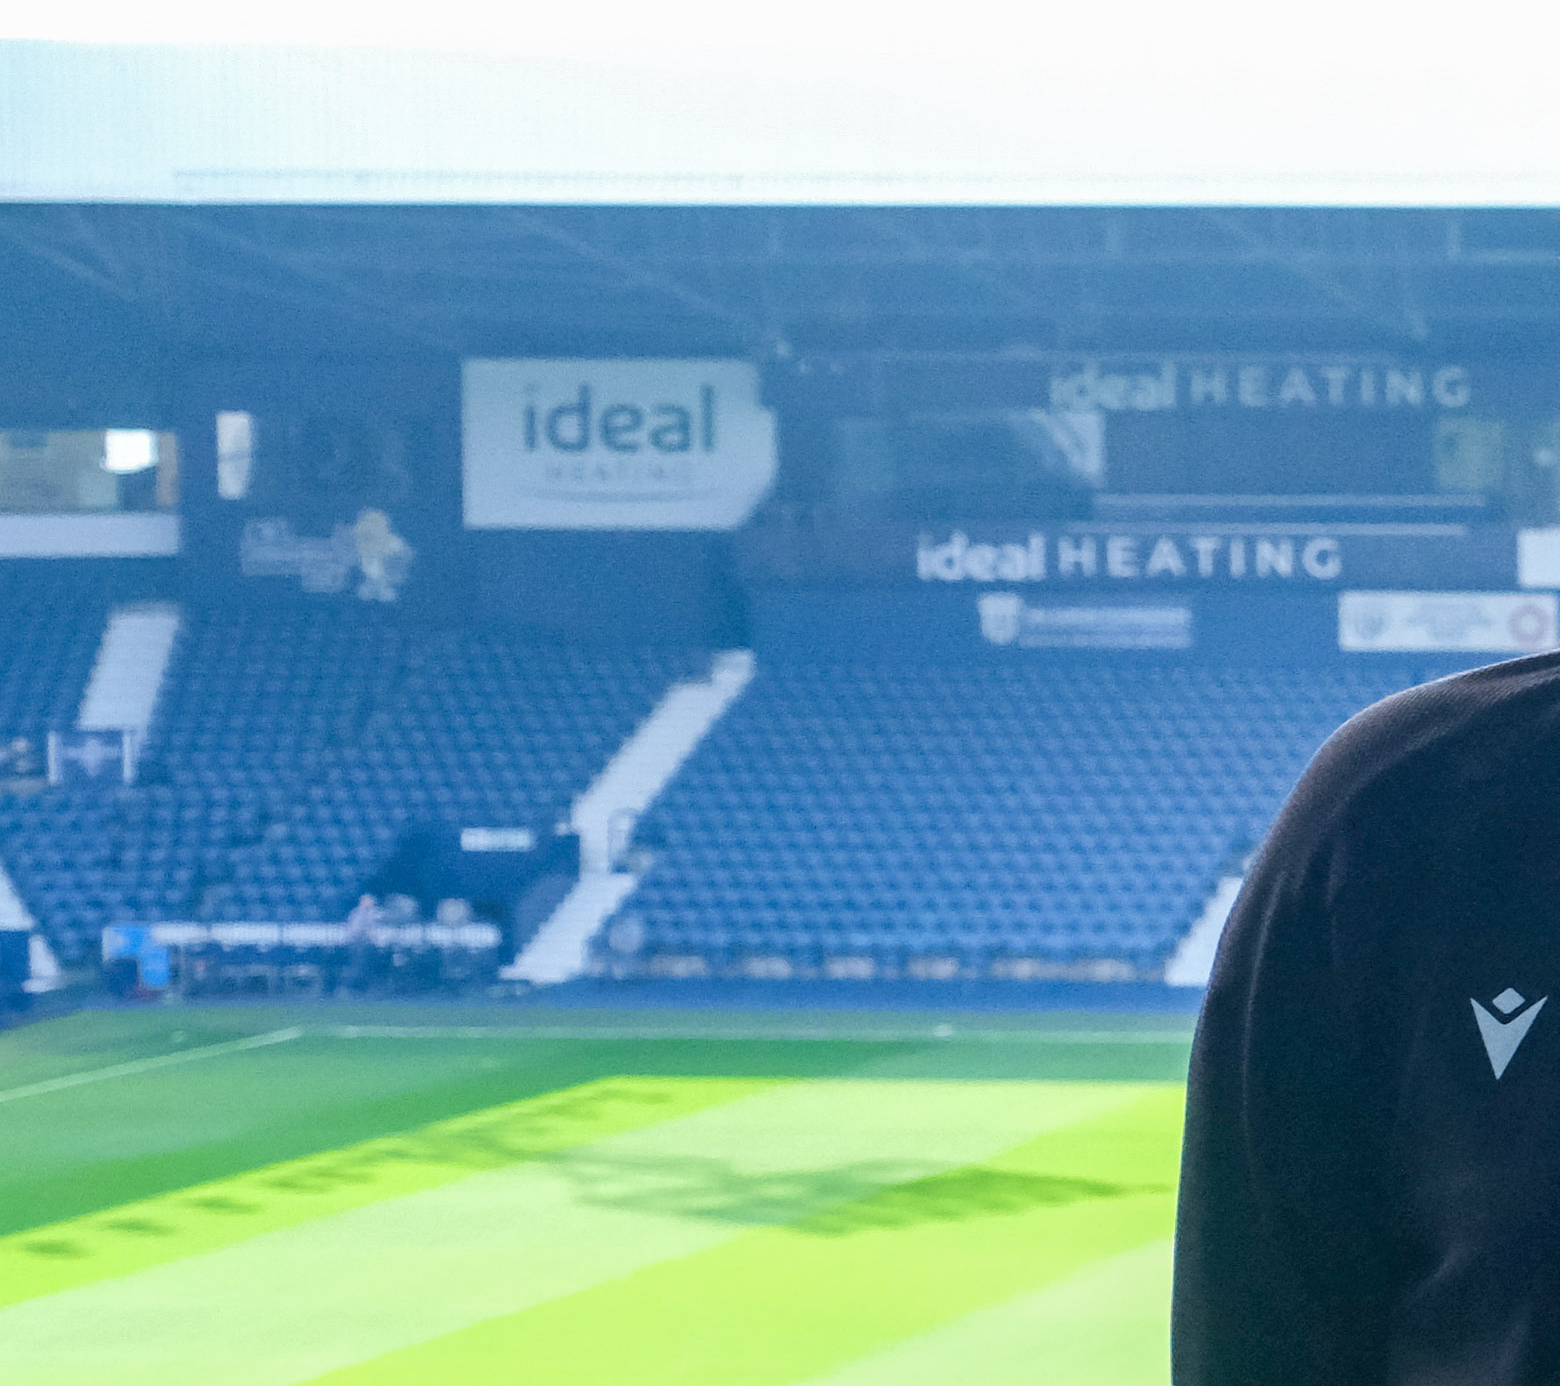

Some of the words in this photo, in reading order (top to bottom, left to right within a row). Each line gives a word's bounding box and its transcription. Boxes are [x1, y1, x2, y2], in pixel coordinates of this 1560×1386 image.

[1190, 366, 1471, 408] HEATING
[523, 382, 716, 454] ideal
[1058, 537, 1342, 579] HEATING
